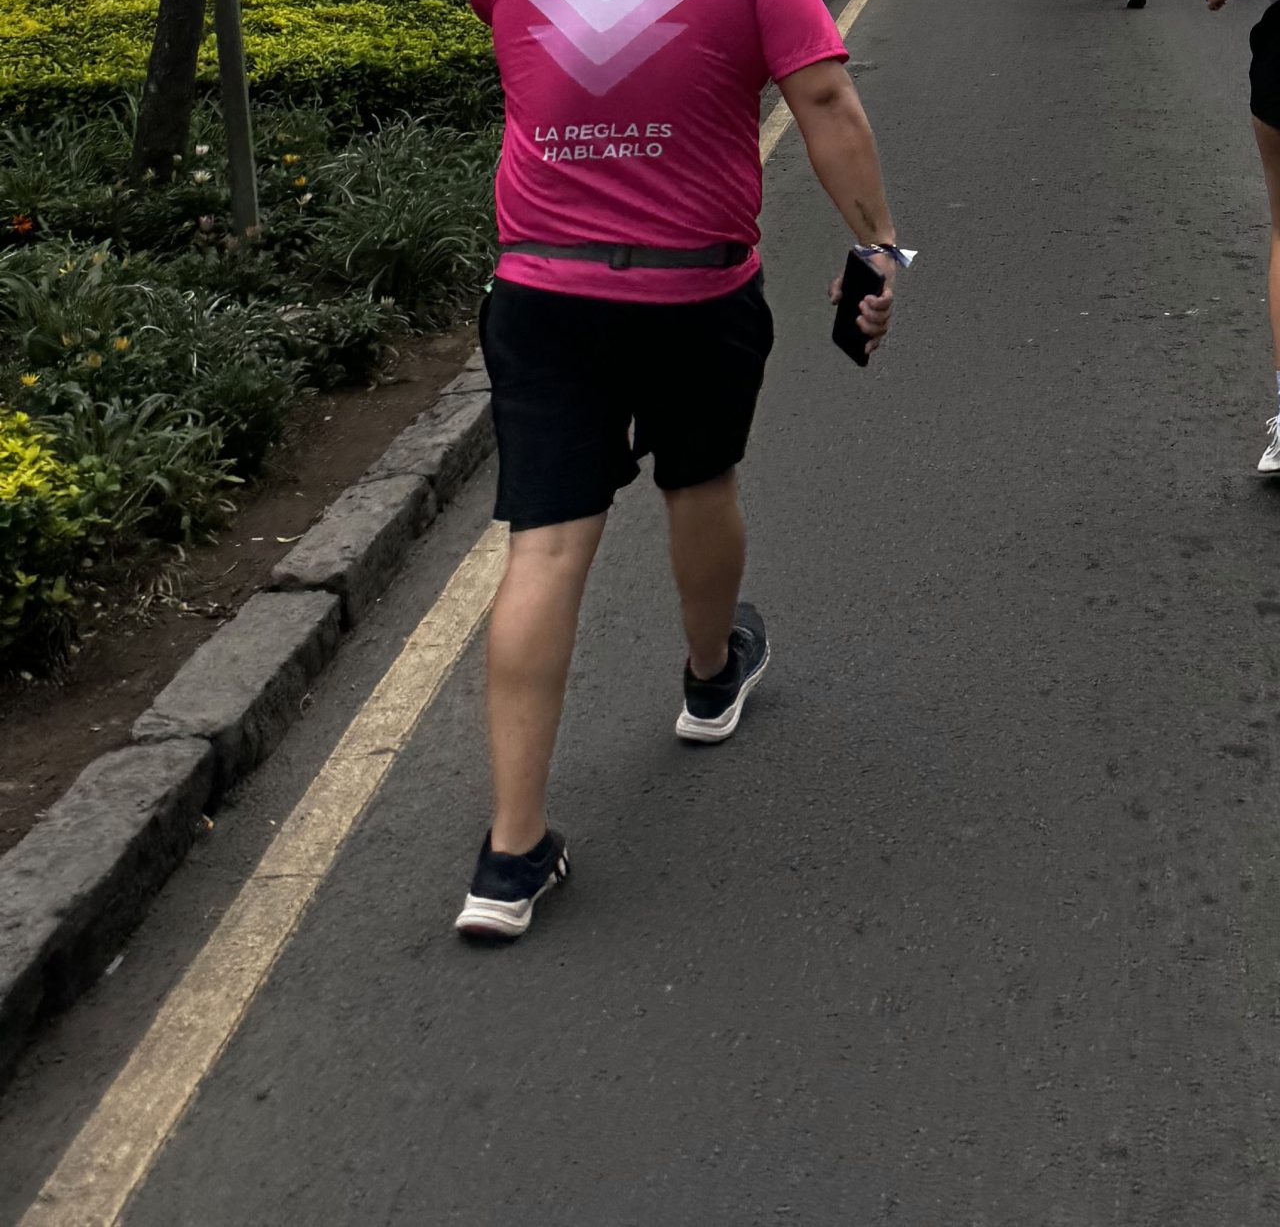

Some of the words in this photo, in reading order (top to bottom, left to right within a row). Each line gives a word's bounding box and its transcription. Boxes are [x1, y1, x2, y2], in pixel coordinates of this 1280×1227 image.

[534, 126, 559, 142] LA
[565, 123, 639, 141] REGLA
[645, 123, 673, 138] ES
[543, 142, 663, 162] HABLARLO
